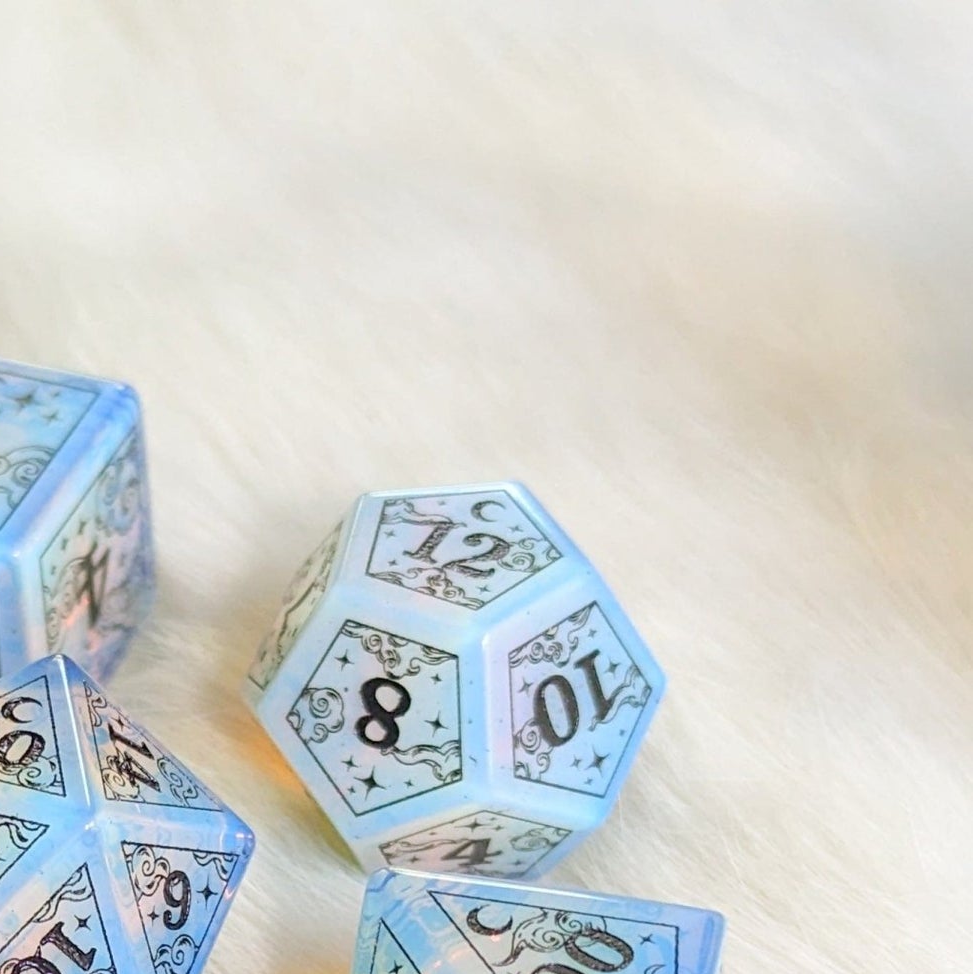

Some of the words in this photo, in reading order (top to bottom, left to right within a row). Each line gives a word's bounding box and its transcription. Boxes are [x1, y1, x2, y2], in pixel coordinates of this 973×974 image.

[403, 520, 514, 579] 12
[354, 676, 412, 750] 8
[533, 648, 619, 749] 10
[440, 837, 502, 866] 4
